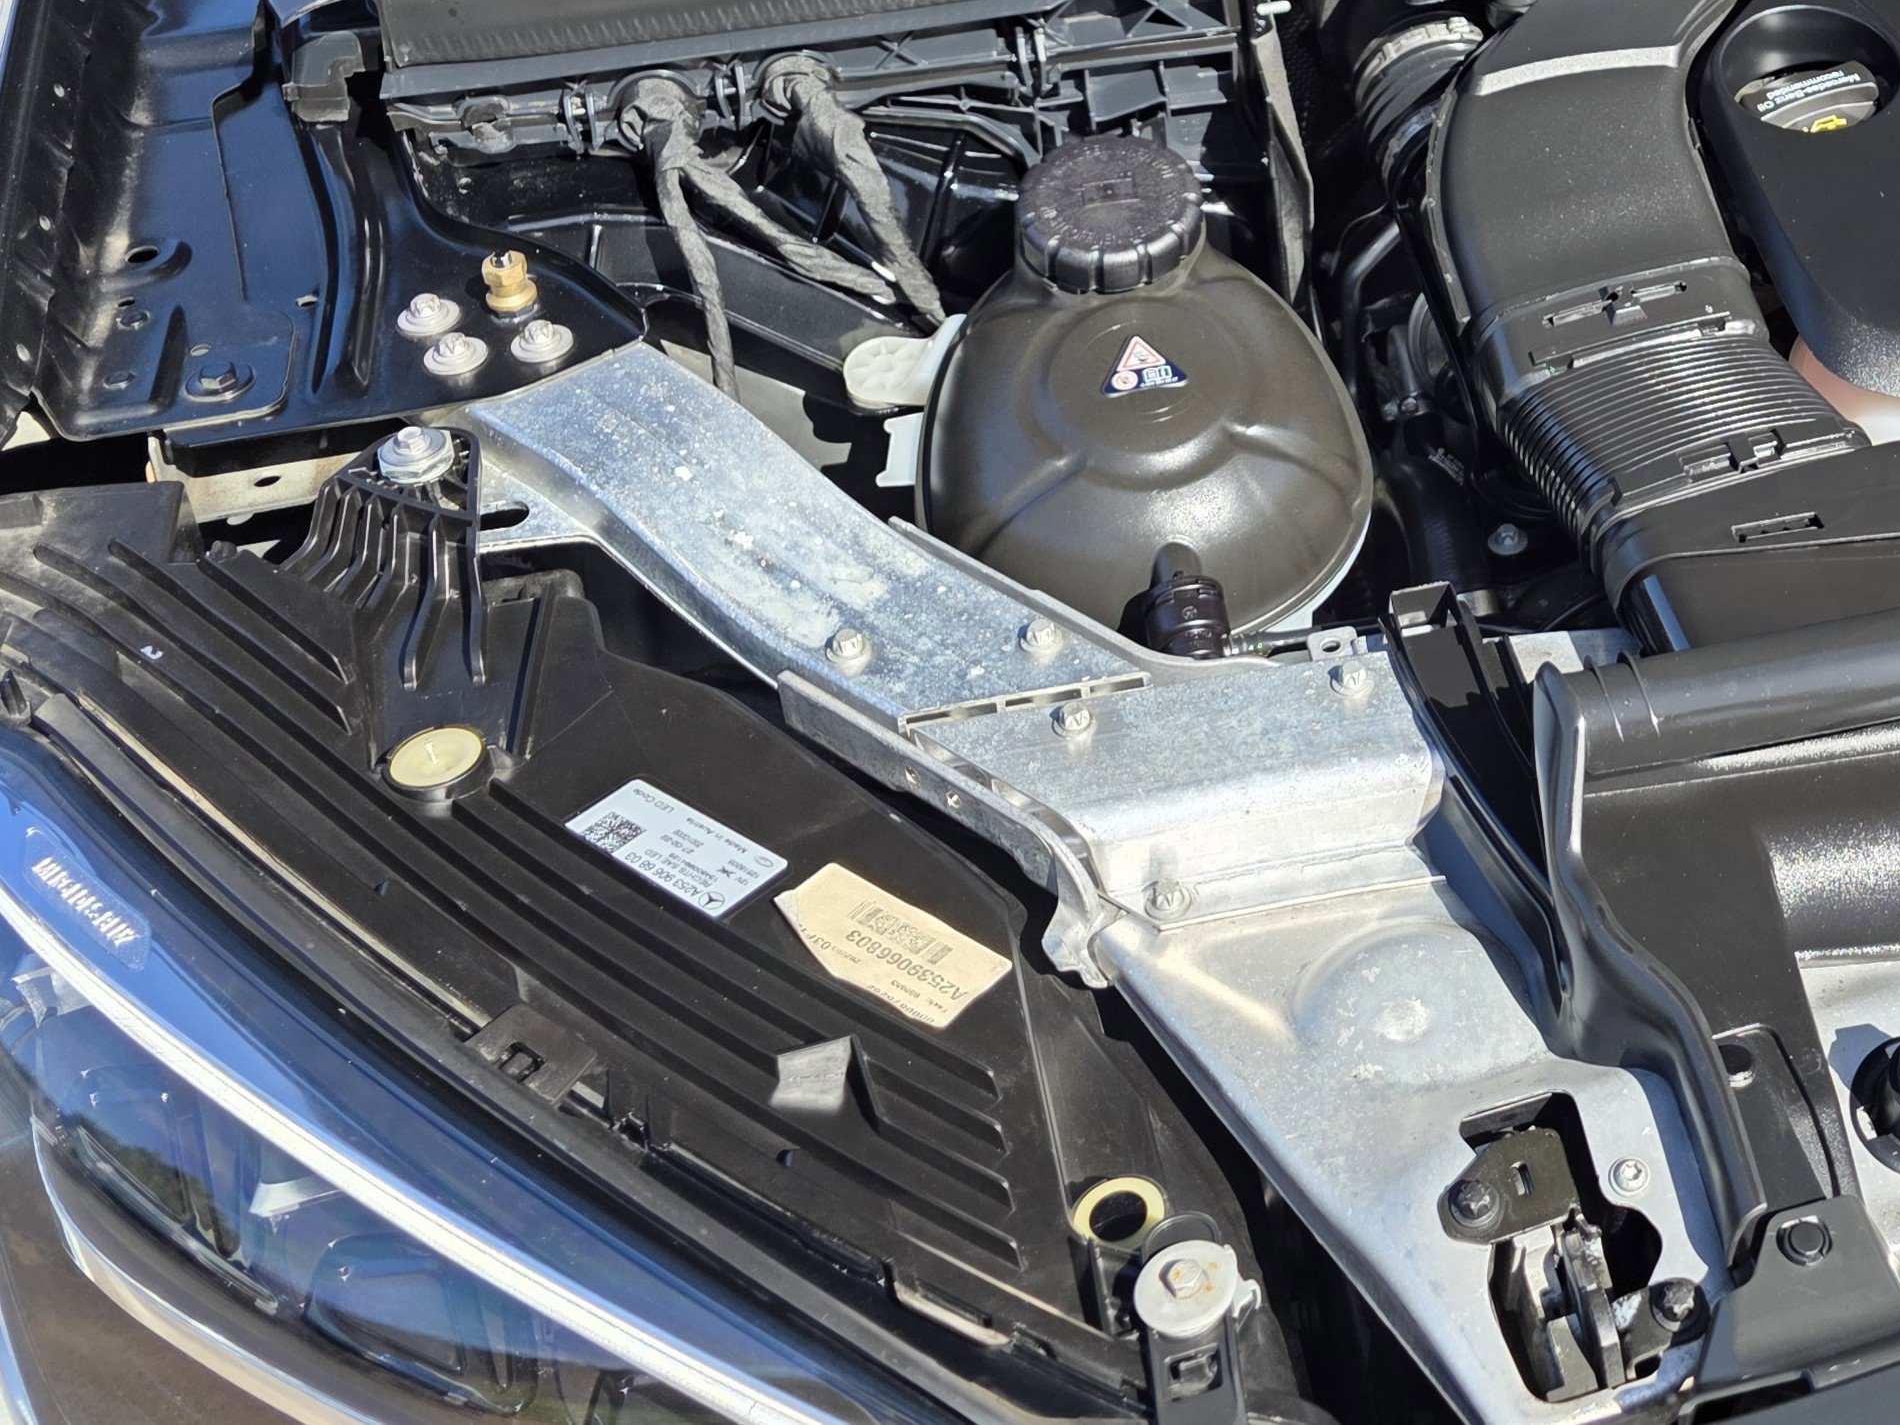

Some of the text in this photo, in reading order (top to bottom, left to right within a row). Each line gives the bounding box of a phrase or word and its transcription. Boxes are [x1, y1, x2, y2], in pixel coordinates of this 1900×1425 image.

[1766, 69, 1844, 100] recommended
[1776, 73, 1861, 105] Mercedes-Benz
[625, 852, 642, 863] 03
[639, 860, 656, 871] 68
[652, 868, 675, 882] 906
[672, 879, 702, 896] A253
[846, 931, 966, 999] A2539066803
